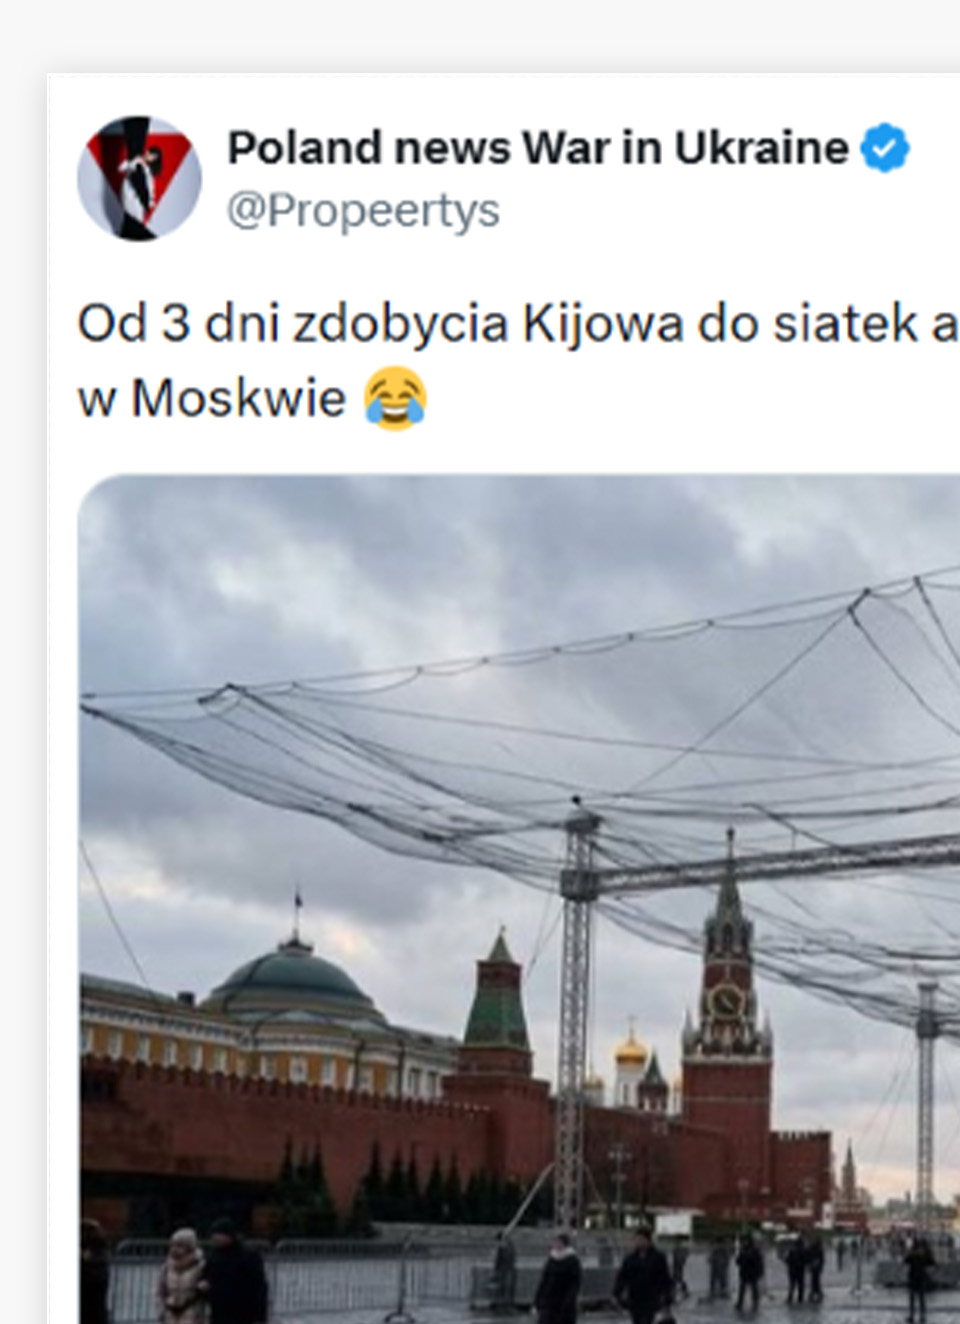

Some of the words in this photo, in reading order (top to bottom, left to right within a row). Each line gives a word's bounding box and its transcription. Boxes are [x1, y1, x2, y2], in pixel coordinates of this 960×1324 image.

[228, 127, 383, 166] Poland
[394, 136, 512, 166] news
[520, 129, 613, 166] War
[622, 127, 663, 166] in
[675, 127, 851, 166] Ukraine
[227, 189, 500, 237] @Propeertys
[76, 299, 148, 344] Od
[160, 301, 192, 344] 3
[203, 299, 281, 344] dni
[291, 299, 509, 353] zdobycia
[522, 299, 685, 353] Kijowa
[696, 299, 760, 344] do
[772, 299, 920, 344] siatek
[75, 386, 119, 419] w
[131, 374, 348, 419] Moskwie
